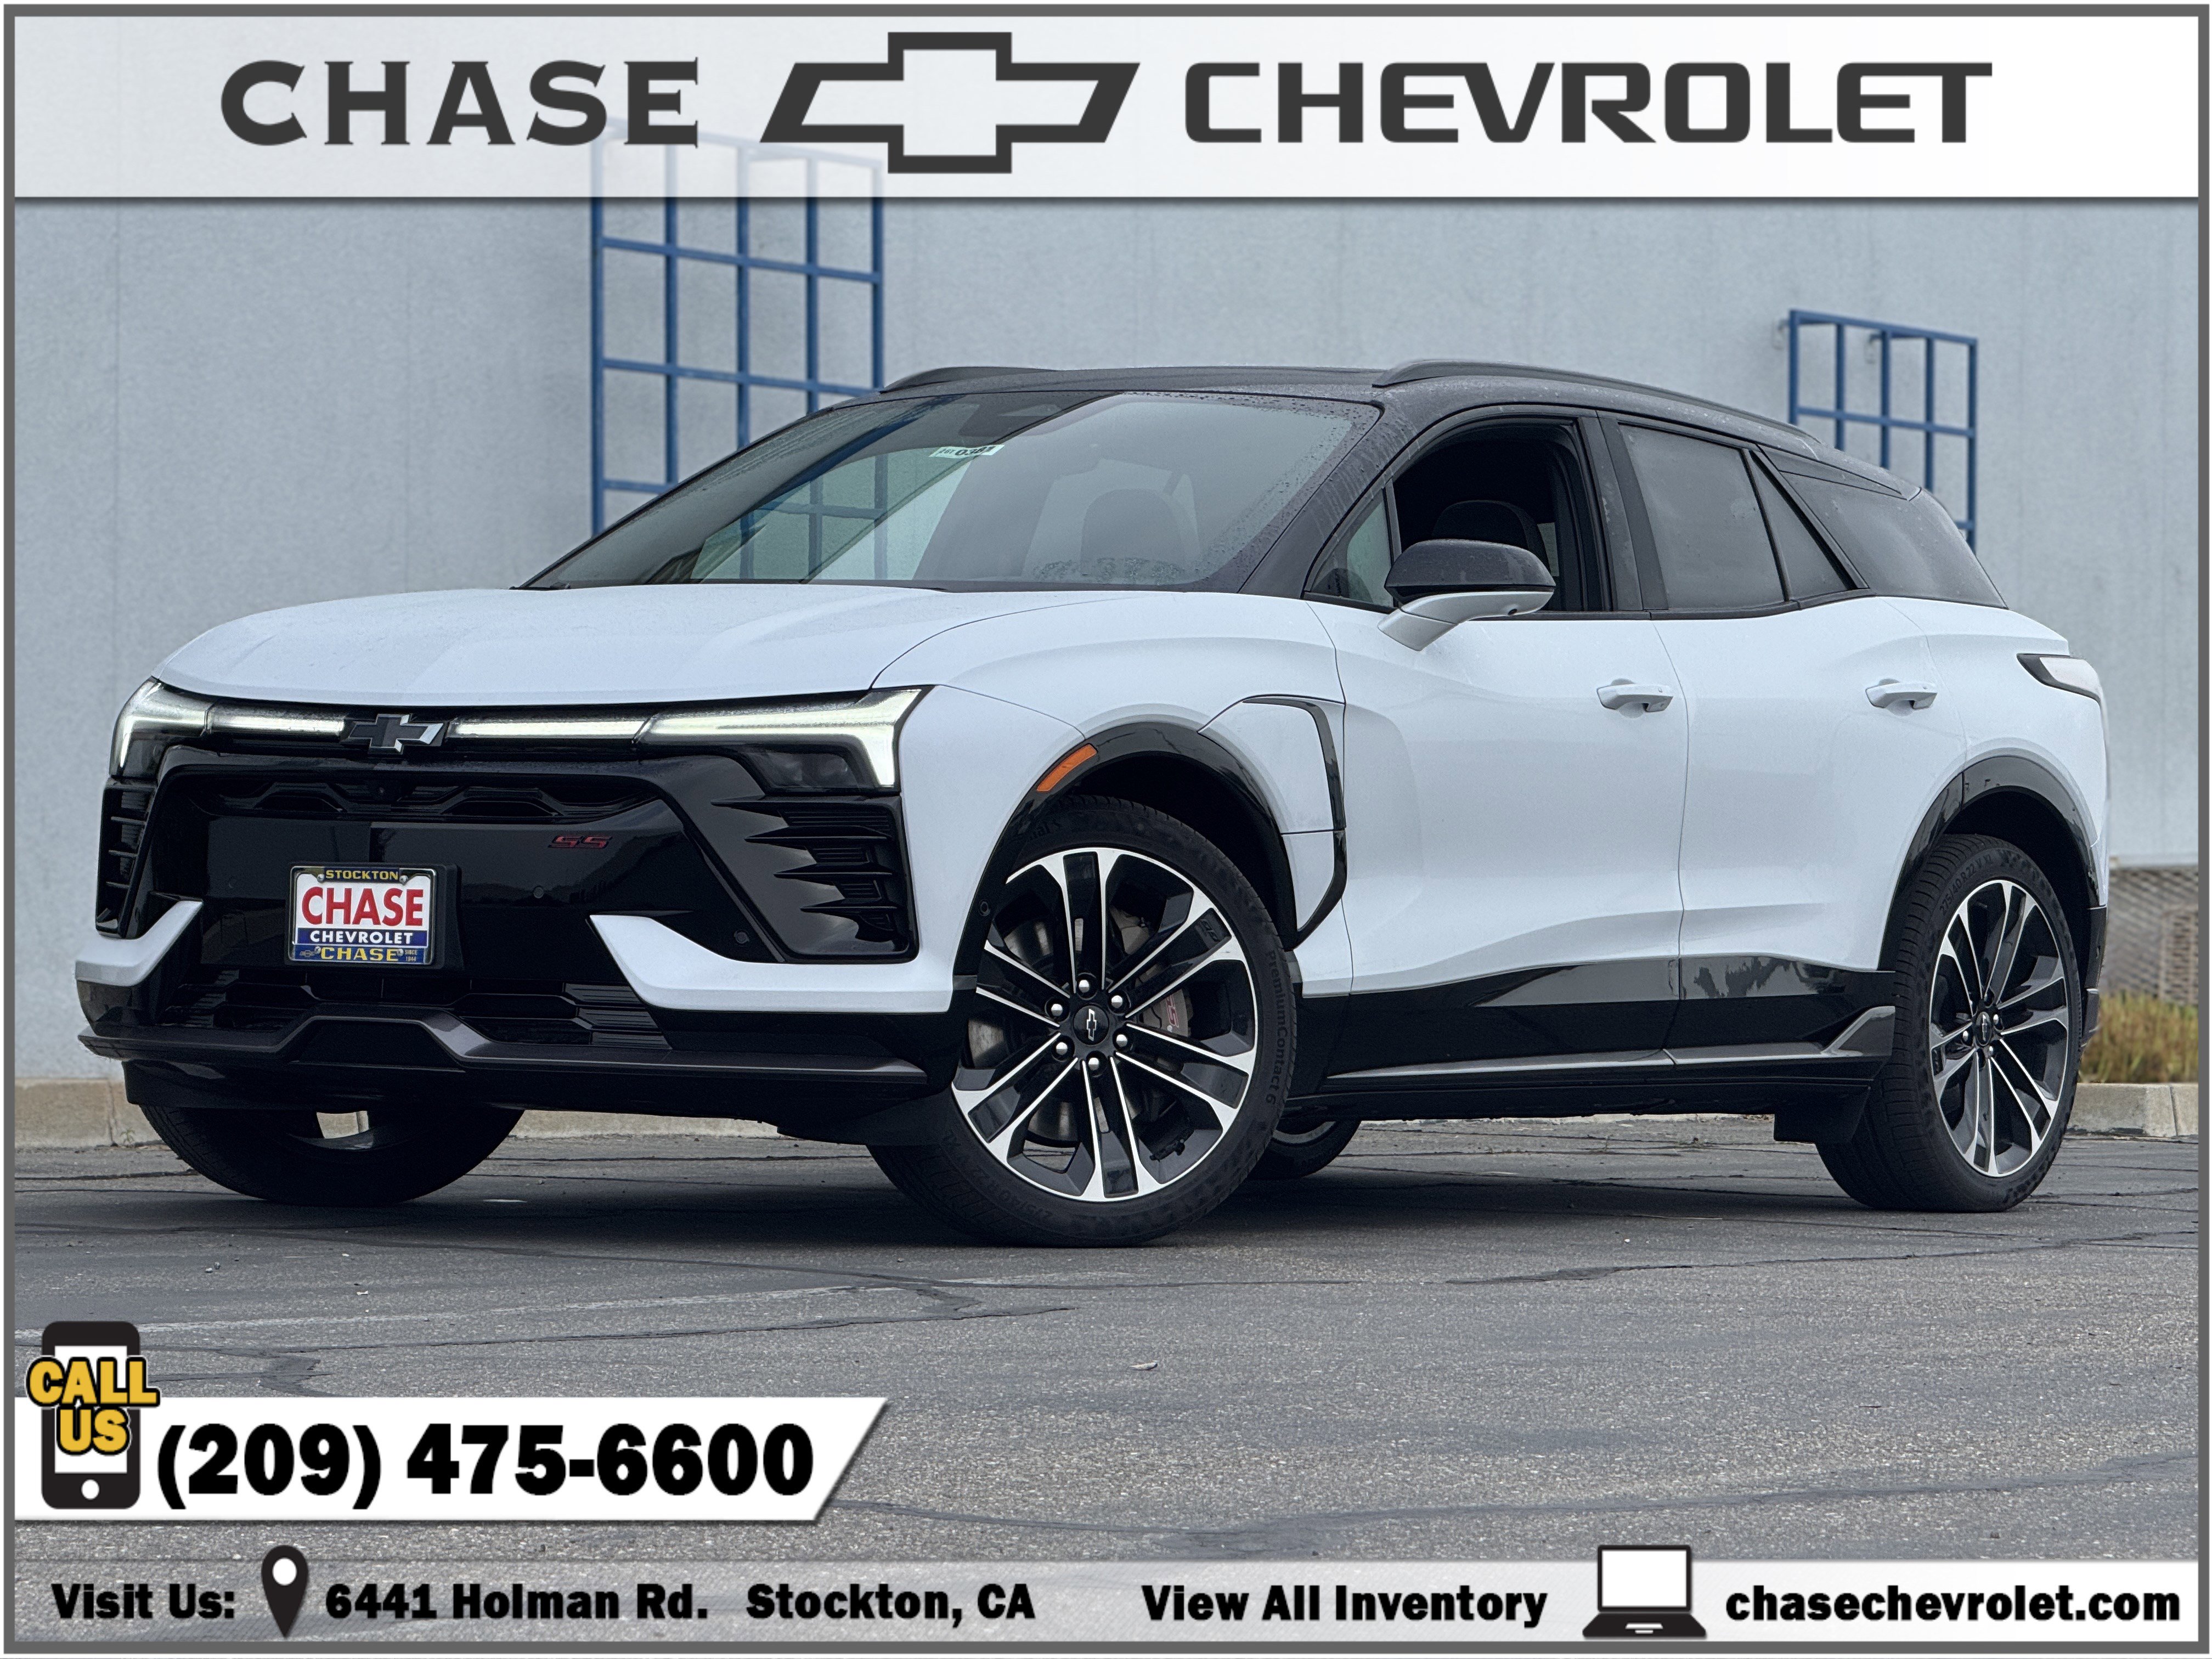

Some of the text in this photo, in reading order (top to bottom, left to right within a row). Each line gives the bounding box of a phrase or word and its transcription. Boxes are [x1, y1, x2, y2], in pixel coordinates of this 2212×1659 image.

[548, 836, 613, 849] SS
[325, 870, 399, 881] STOCKTON
[302, 887, 424, 927] CHASE
[310, 930, 413, 945] CHEVROLET
[320, 947, 399, 962] CHASE
[1266, 950, 1288, 1091] PremiumContact
